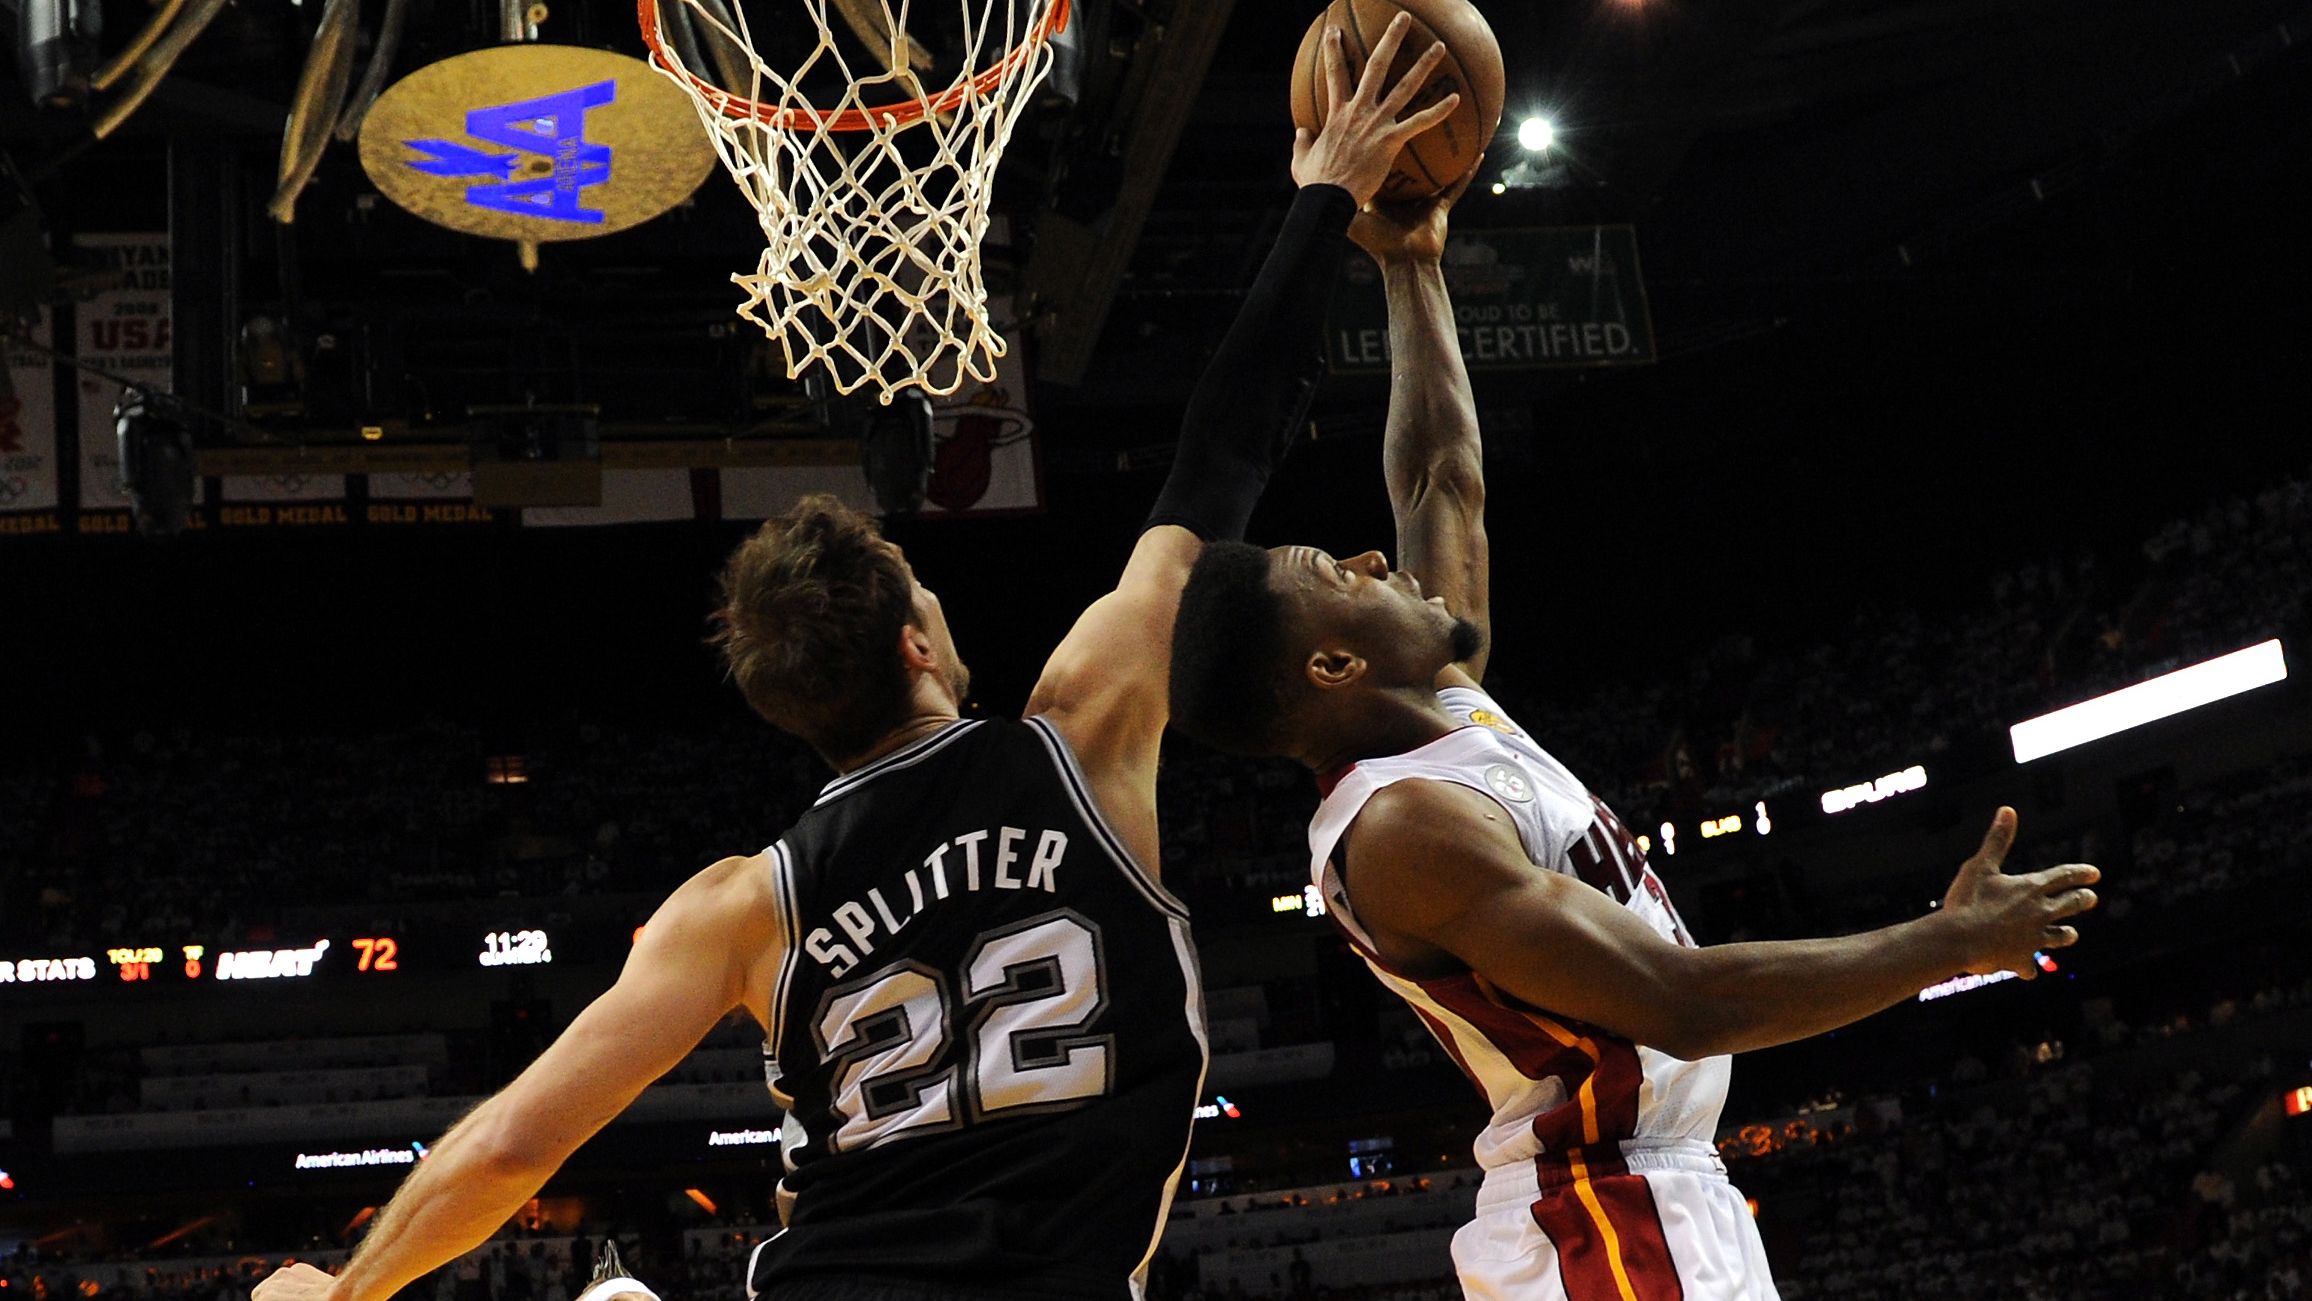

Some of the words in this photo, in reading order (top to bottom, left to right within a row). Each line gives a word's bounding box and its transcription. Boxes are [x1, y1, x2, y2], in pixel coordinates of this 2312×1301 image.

[220, 505, 271, 526] GOLD
[275, 504, 350, 526] MEDAL
[367, 502, 417, 524] GOLD
[421, 502, 493, 524] MEDAL
[805, 826, 1069, 980] SPLITTER
[215, 939, 330, 980] HEAT
[352, 938, 398, 971] 72
[16, 957, 97, 982] STATS
[809, 905, 1117, 1155] 22
[708, 1129, 773, 1146] American
[295, 1152, 361, 1169] American
[361, 1148, 414, 1165] Airlines
